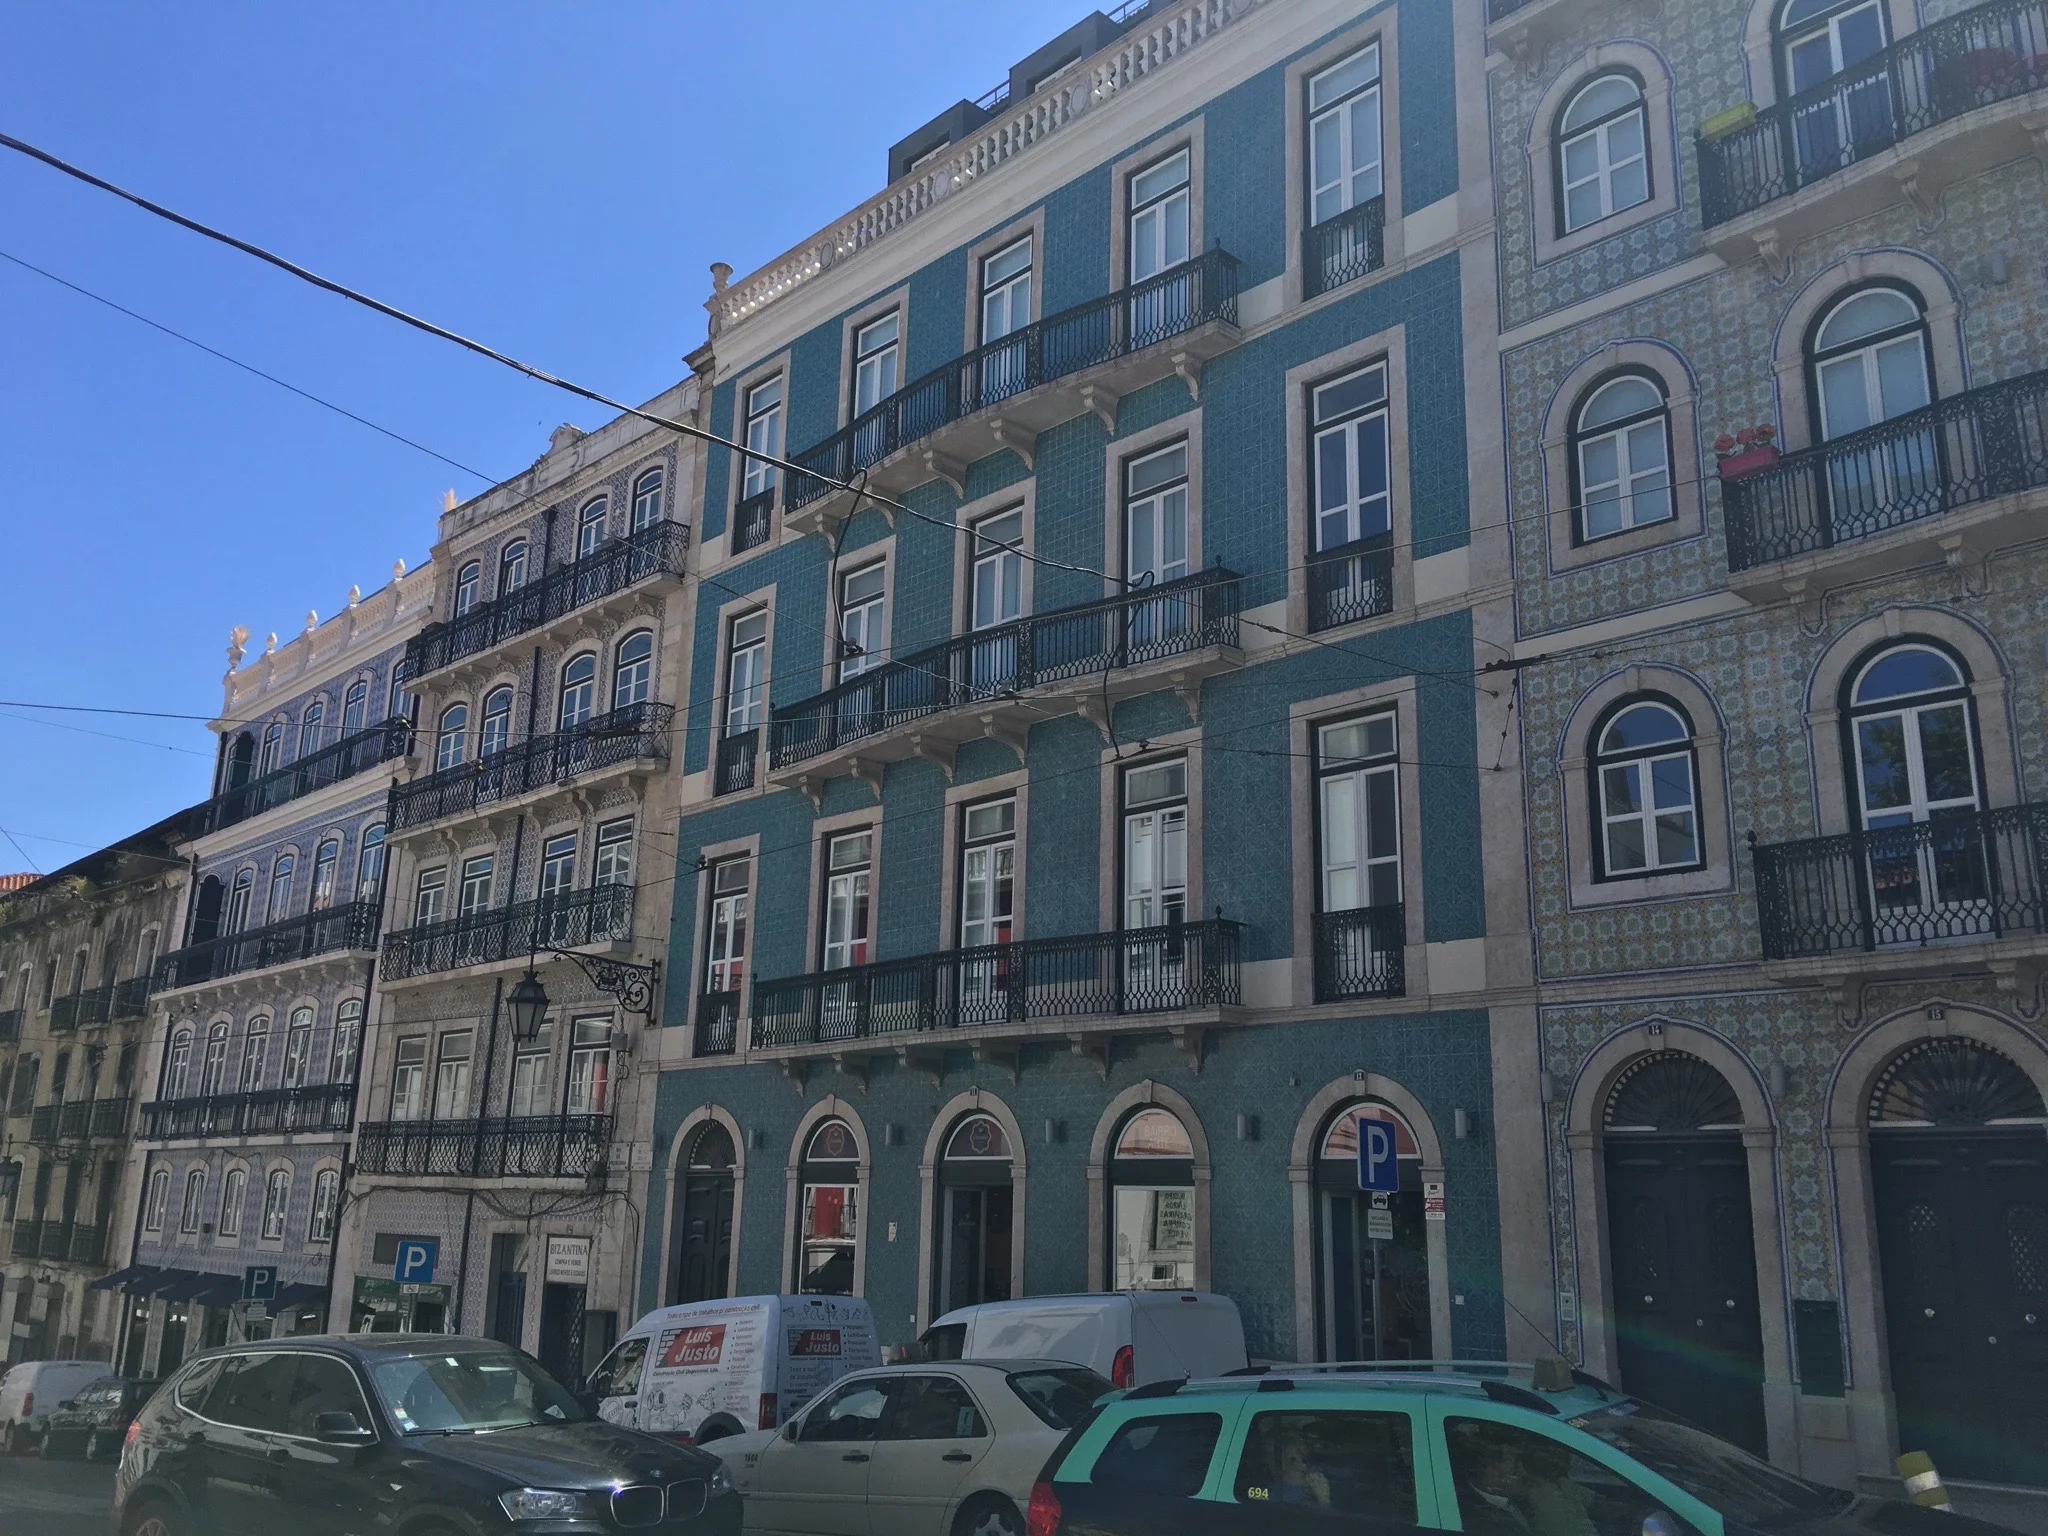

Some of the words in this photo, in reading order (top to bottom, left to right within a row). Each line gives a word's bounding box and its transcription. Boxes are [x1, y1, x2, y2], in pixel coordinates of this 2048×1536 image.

[1931, 1010, 1941, 1020] 15
[1144, 1125, 1177, 1137] BAIRRO
[1367, 1125, 1389, 1183] P
[550, 1243, 588, 1256] BIZANTINA
[403, 1246, 427, 1278] P
[251, 1269, 269, 1297] P
[685, 1327, 713, 1344] Luís
[810, 1331, 831, 1341] Luís
[674, 1343, 719, 1363] Justo
[805, 1342, 840, 1353] Justo
[1248, 1486, 1269, 1499] 694
